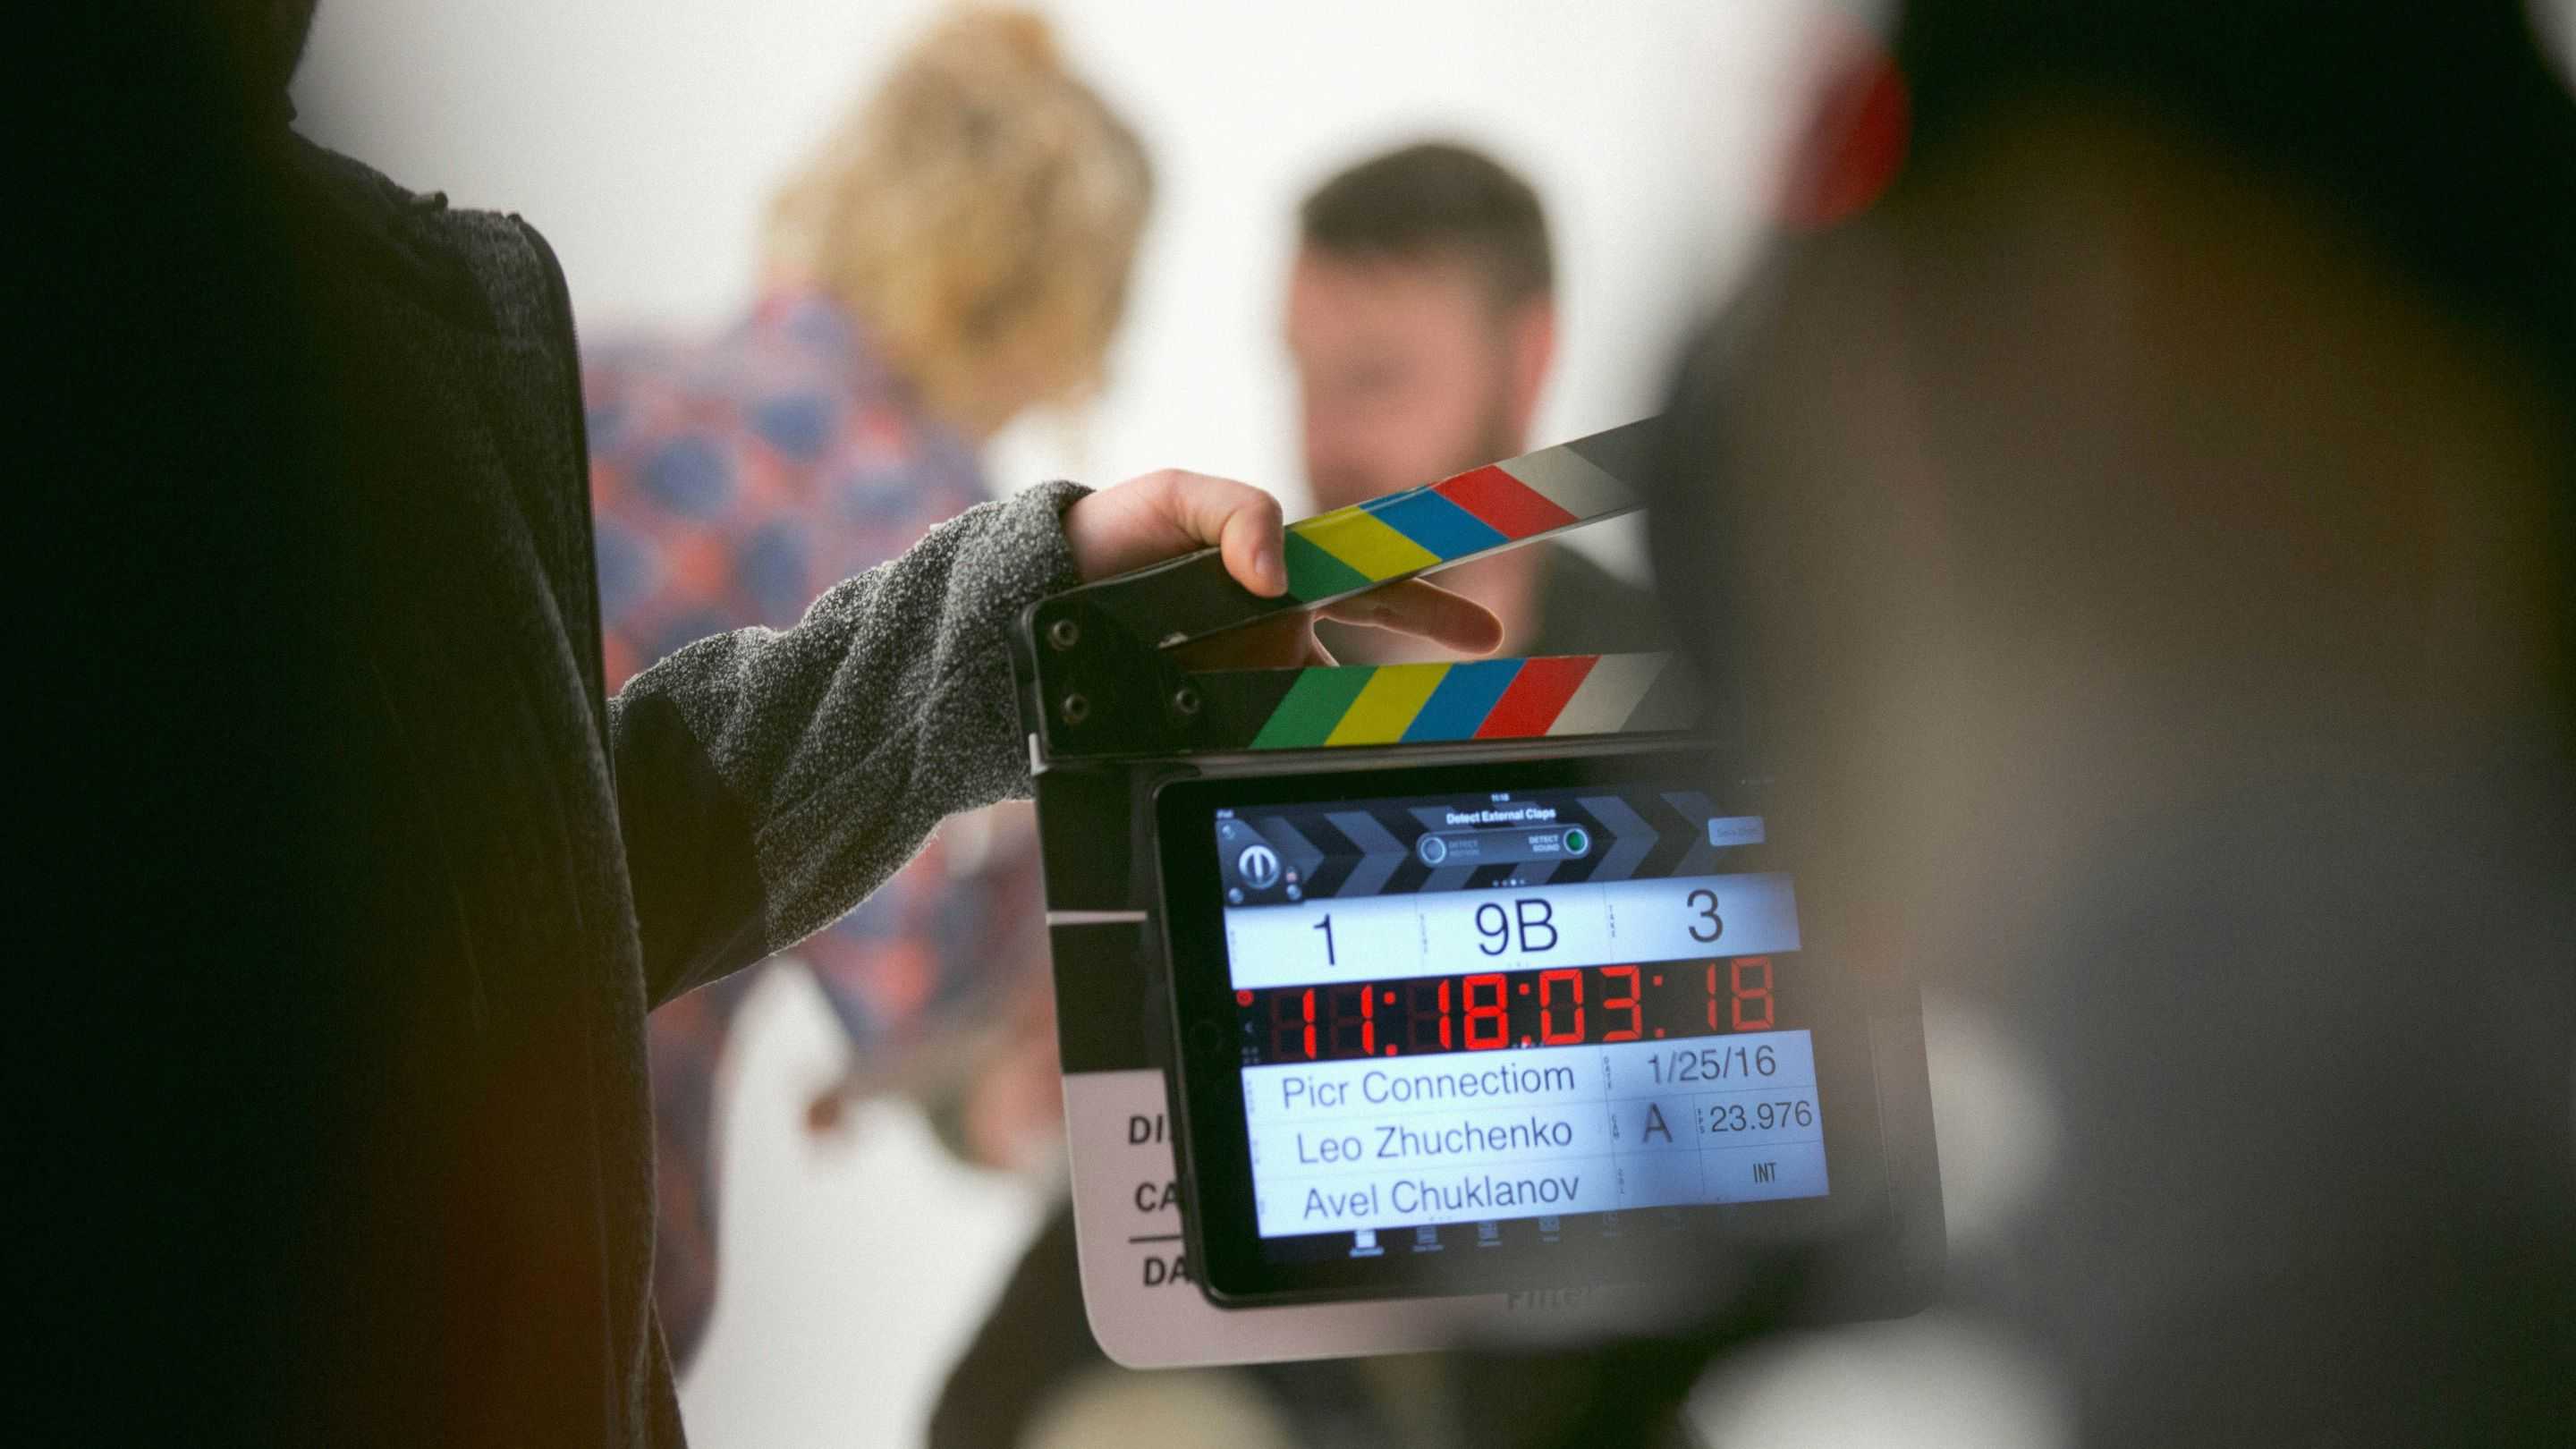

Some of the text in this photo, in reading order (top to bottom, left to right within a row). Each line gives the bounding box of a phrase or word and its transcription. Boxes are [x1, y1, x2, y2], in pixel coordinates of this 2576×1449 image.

[1446, 807, 1556, 825] Detect External Claps
[1529, 834, 1559, 845] DETECT
[1475, 897, 1558, 956] 9B
[1687, 888, 1725, 944] 3
[1312, 914, 1338, 967] 1
[1282, 1075, 1350, 1109] Picr
[1361, 1063, 1576, 1102] Connectiom
[1647, 1044, 1777, 1085] 1/25/16
[1642, 1102, 1674, 1144] A
[1709, 1099, 1814, 1133] 23.976
[1296, 1132, 1362, 1165] Leo
[1375, 1116, 1573, 1159] Zhuchenko
[1752, 1162, 1777, 1184] INT
[1303, 1184, 1379, 1220] Avel
[1390, 1174, 1580, 1215] Chuklanov
